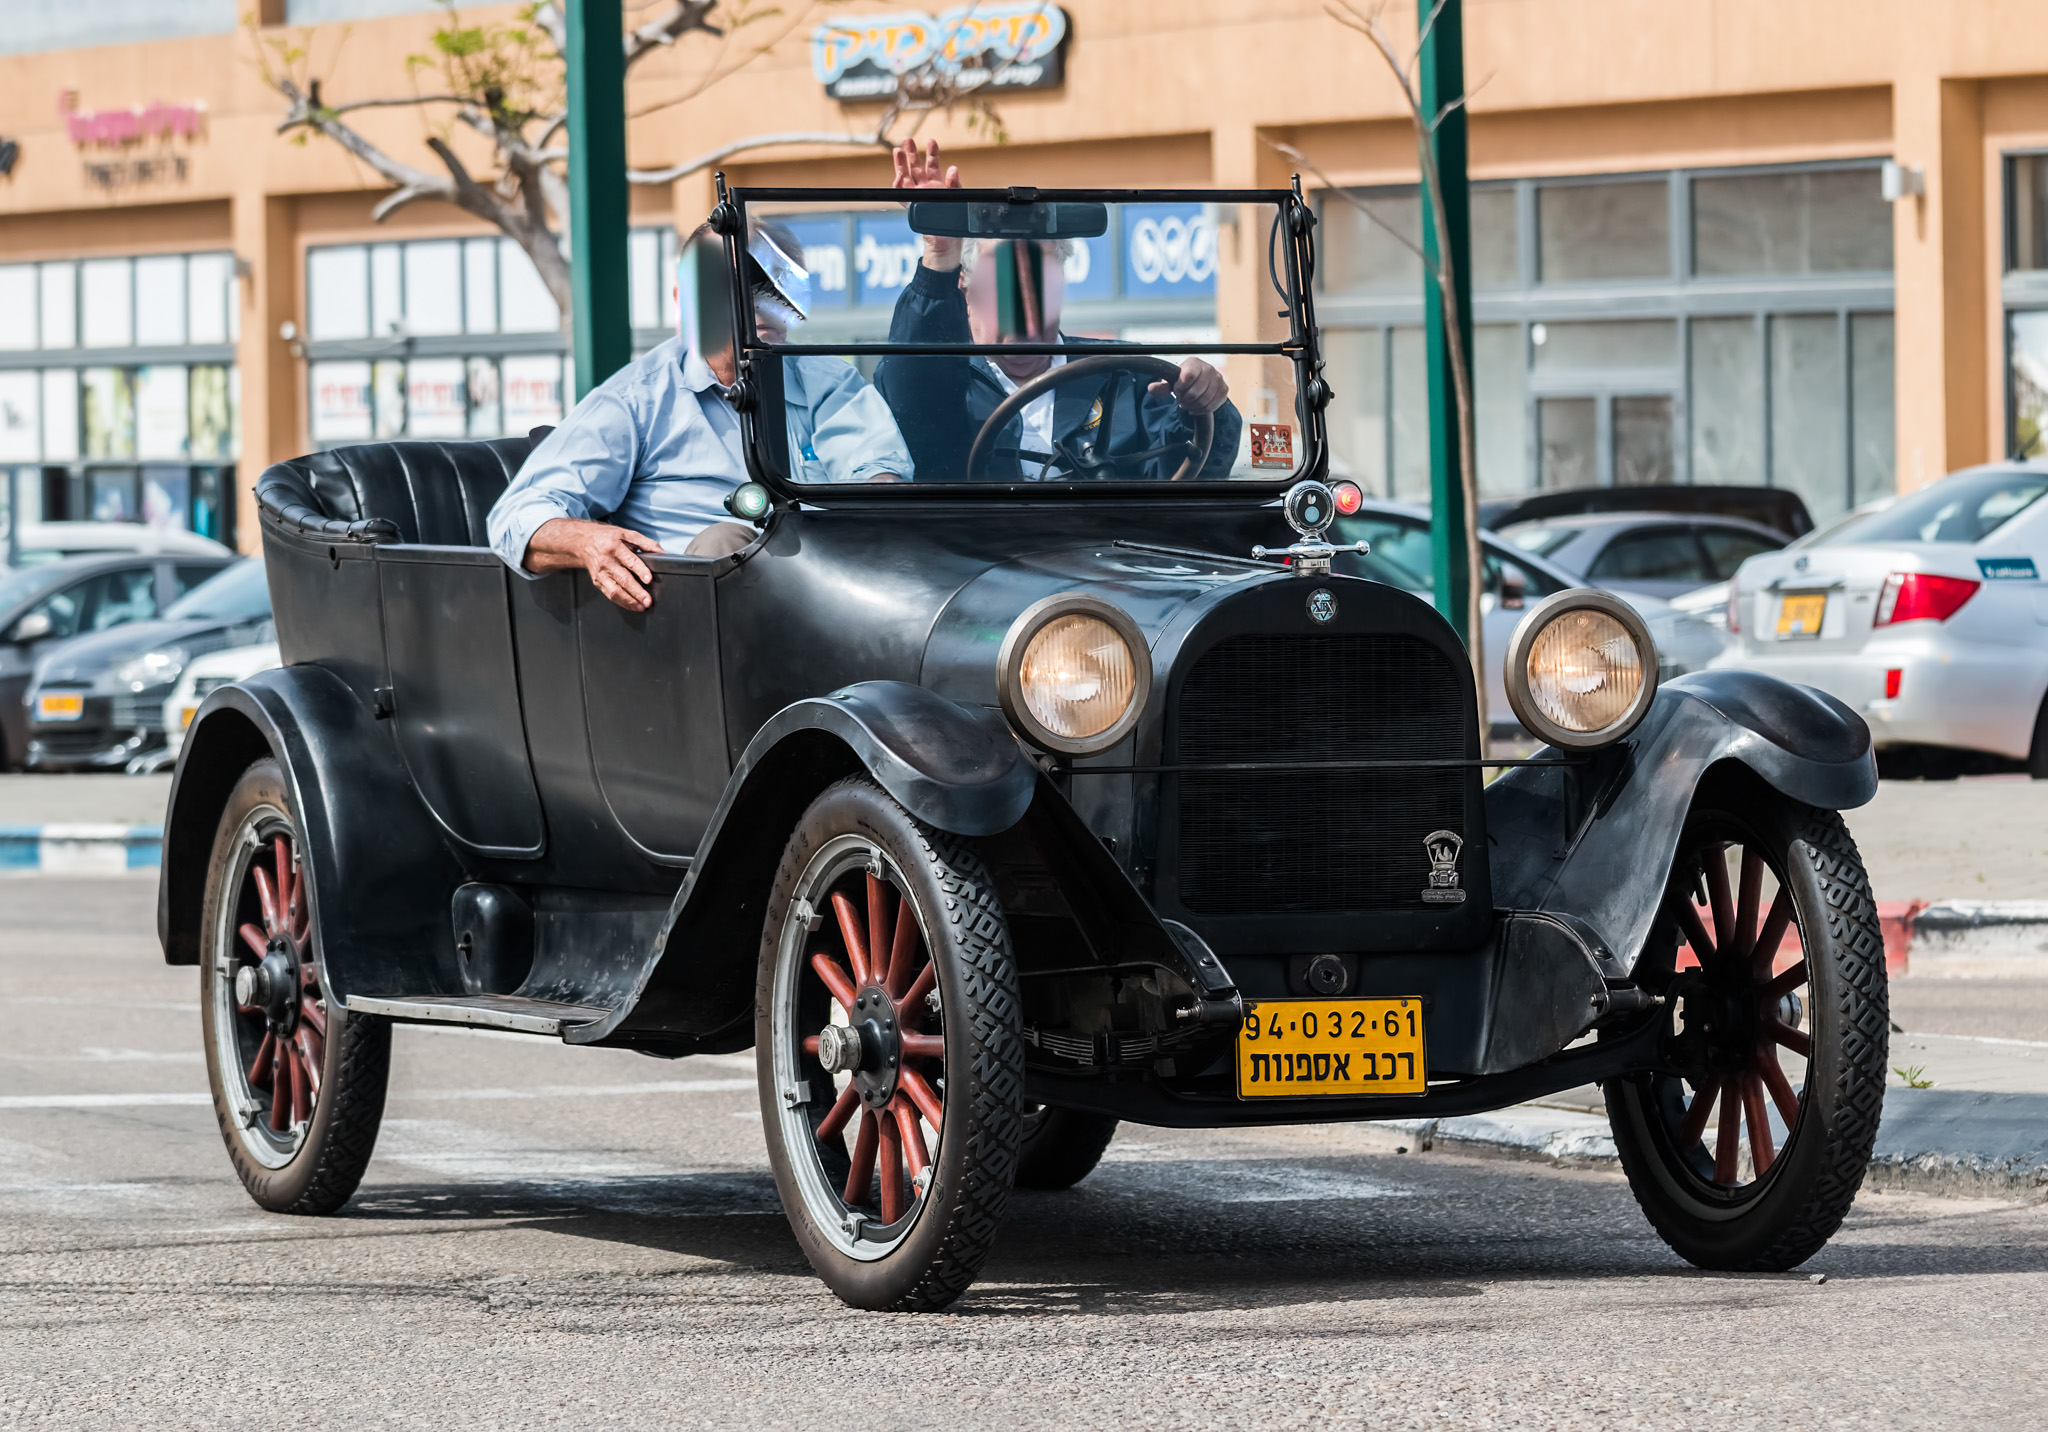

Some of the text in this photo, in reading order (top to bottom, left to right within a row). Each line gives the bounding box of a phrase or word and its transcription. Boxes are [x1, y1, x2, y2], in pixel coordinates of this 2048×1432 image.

[1252, 440, 1263, 457] 3
[1250, 1052, 1415, 1083] רכב אספנות
